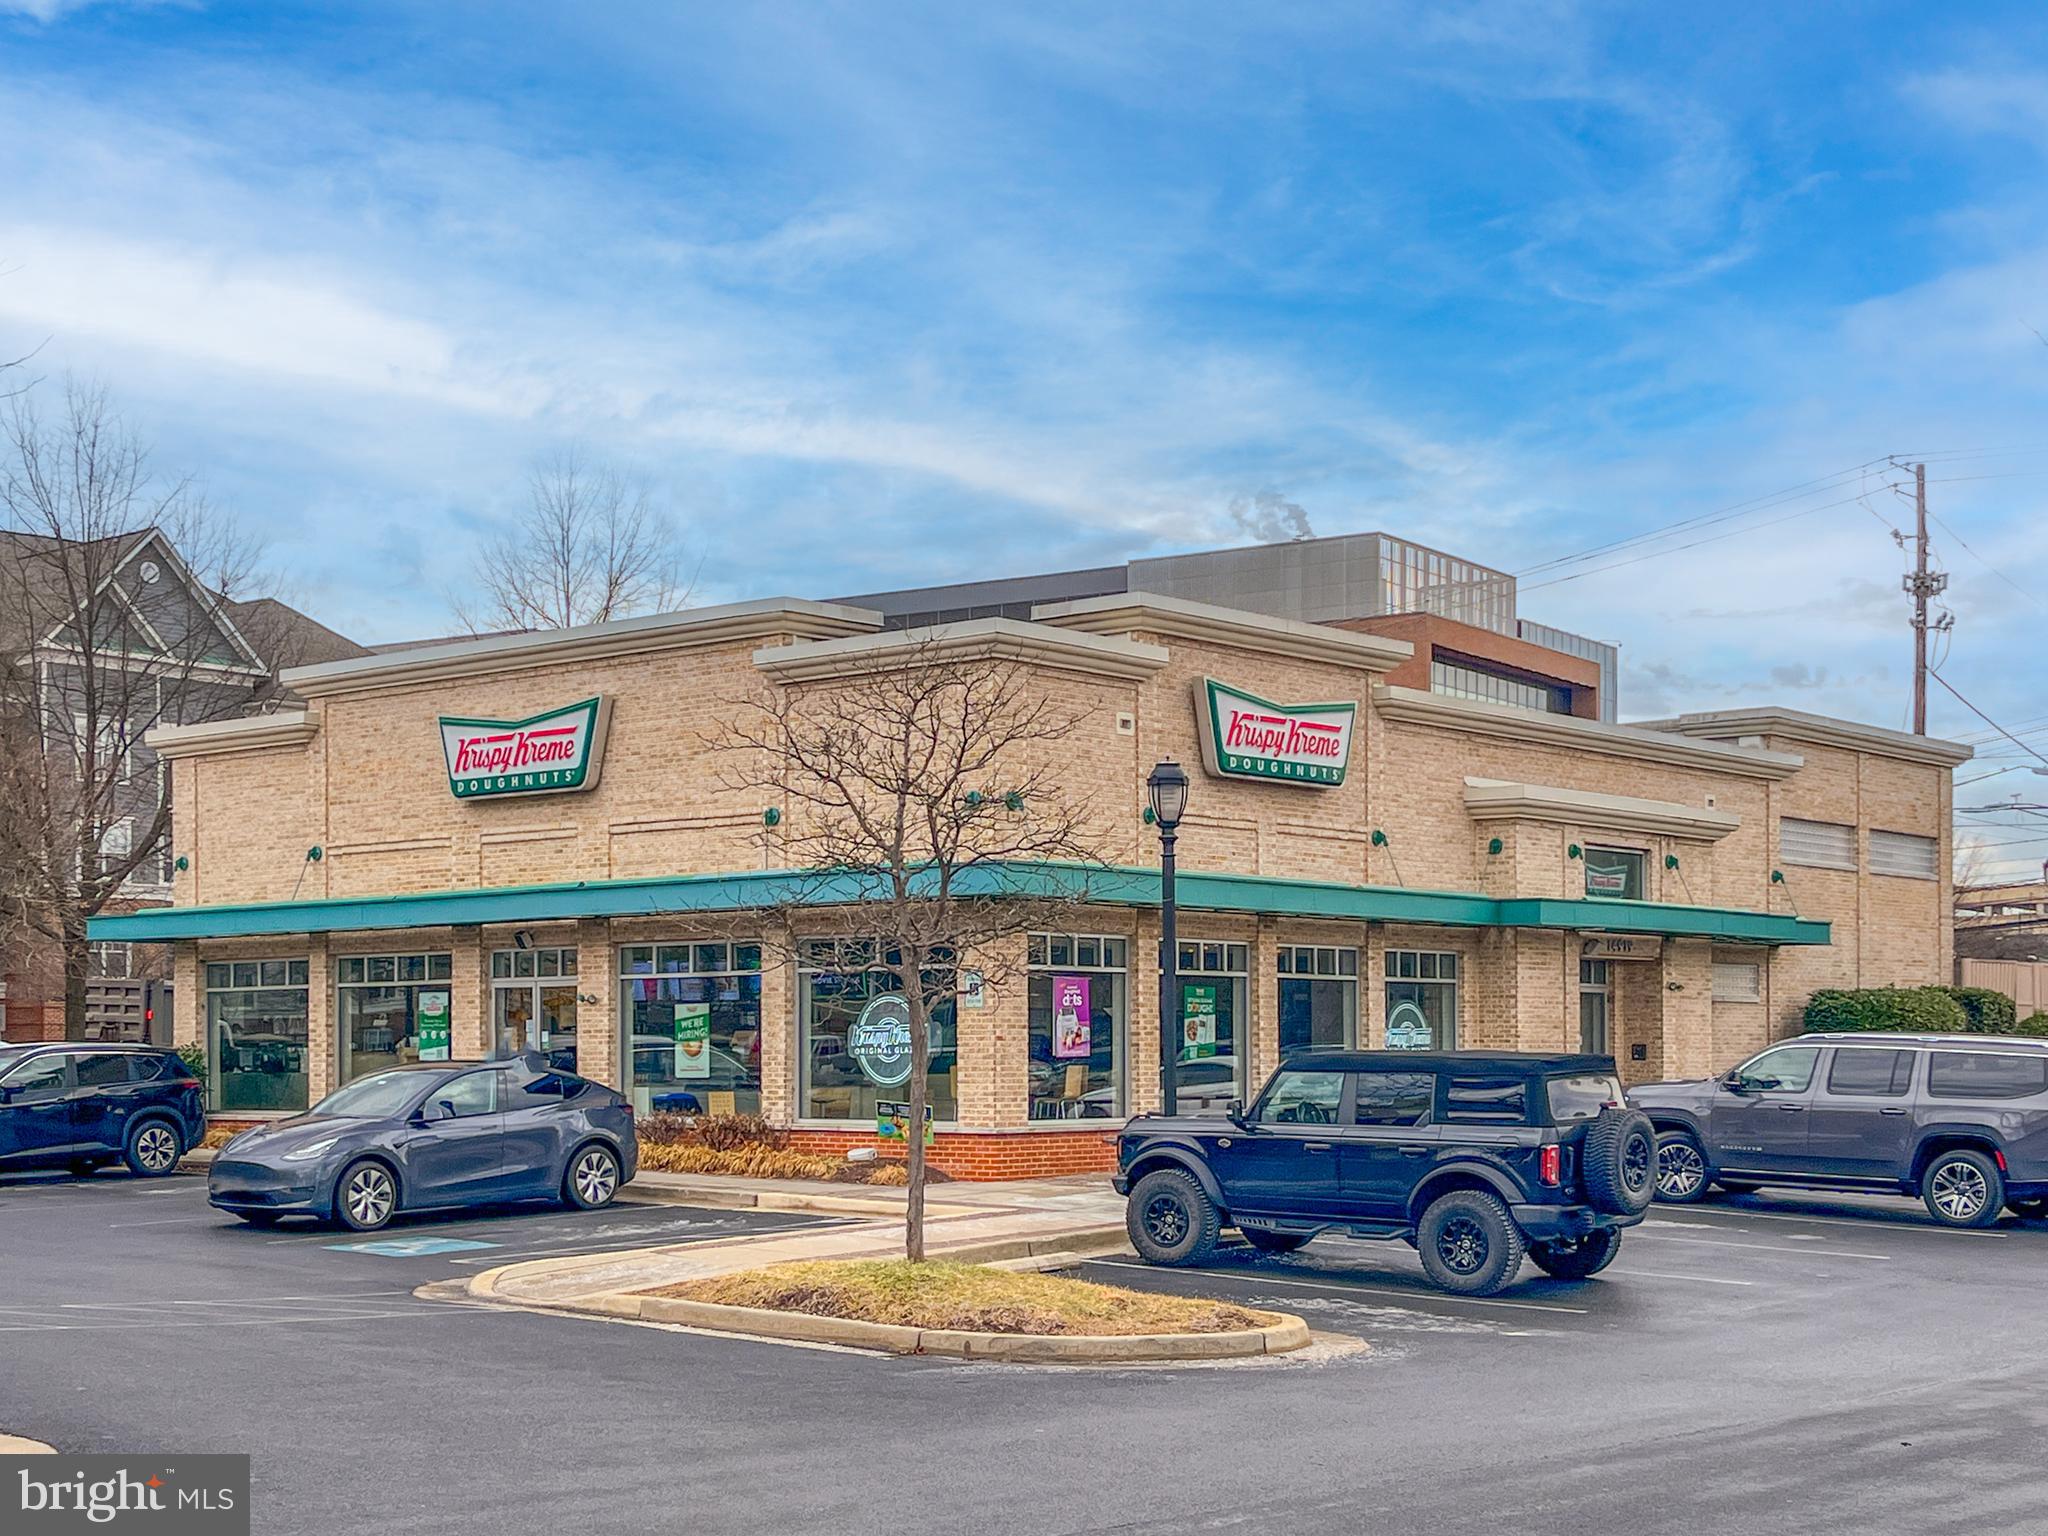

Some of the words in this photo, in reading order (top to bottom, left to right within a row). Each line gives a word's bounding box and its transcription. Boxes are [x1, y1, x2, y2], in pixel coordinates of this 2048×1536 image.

[1226, 710, 1286, 757] Krispy
[1285, 718, 1342, 757] Kreme
[454, 733, 515, 774] Krispy
[514, 726, 578, 767] Kreme
[1229, 756, 1339, 781] DOUGHNUTS
[457, 770, 573, 793] DOUGHNUTS
[854, 1047, 892, 1055] ORIGINAL
